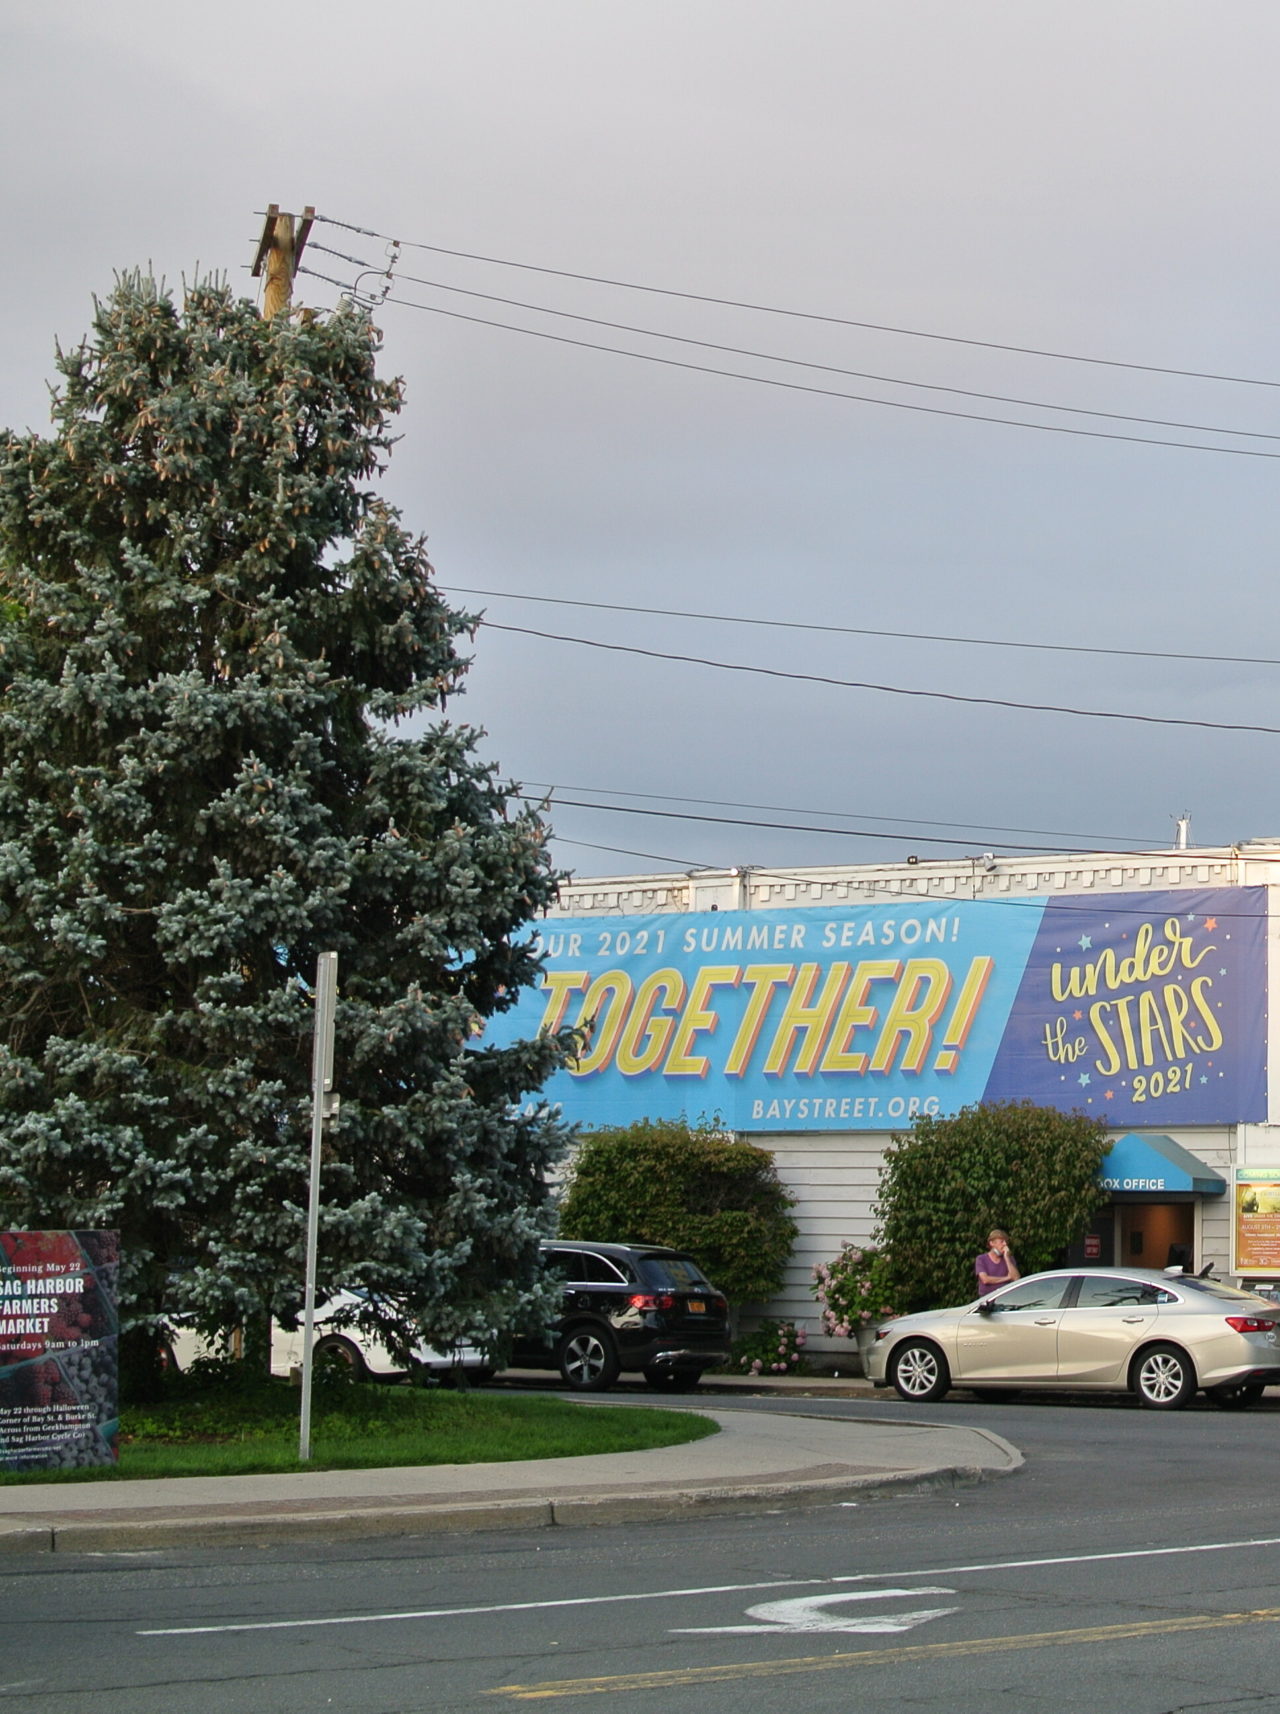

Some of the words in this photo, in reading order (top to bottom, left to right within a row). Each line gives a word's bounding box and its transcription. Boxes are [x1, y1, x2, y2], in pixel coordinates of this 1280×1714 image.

[597, 930, 666, 957] 2021
[683, 924, 806, 953] SUMMER
[822, 917, 960, 948] SEASON!
[1051, 917, 1217, 1002] under
[536, 956, 995, 1080] TOGETHER!
[1041, 1016, 1089, 1064] the
[1089, 976, 1223, 1076] STARS
[1132, 1062, 1193, 1103] 2021
[751, 1096, 940, 1119] BAYSTREET.ORG
[1123, 1178, 1165, 1190] OFFICE
[46, 1262, 66, 1273] May
[69, 1262, 81, 1271] 22
[27, 1278, 84, 1295] HARBOR
[0, 1318, 50, 1334] MARKET
[0, 1340, 42, 1351] aturdays
[45, 1340, 65, 1349] 9am
[68, 1339, 77, 1347] to
[81, 1338, 99, 1349] 1pm
[23, 1405, 51, 1414] through
[53, 1403, 90, 1412] Halloween
[22, 1415, 31, 1423] of
[32, 1414, 45, 1424] Bay
[23, 1424, 41, 1432] from
[25, 1433, 50, 1442] Harbor
